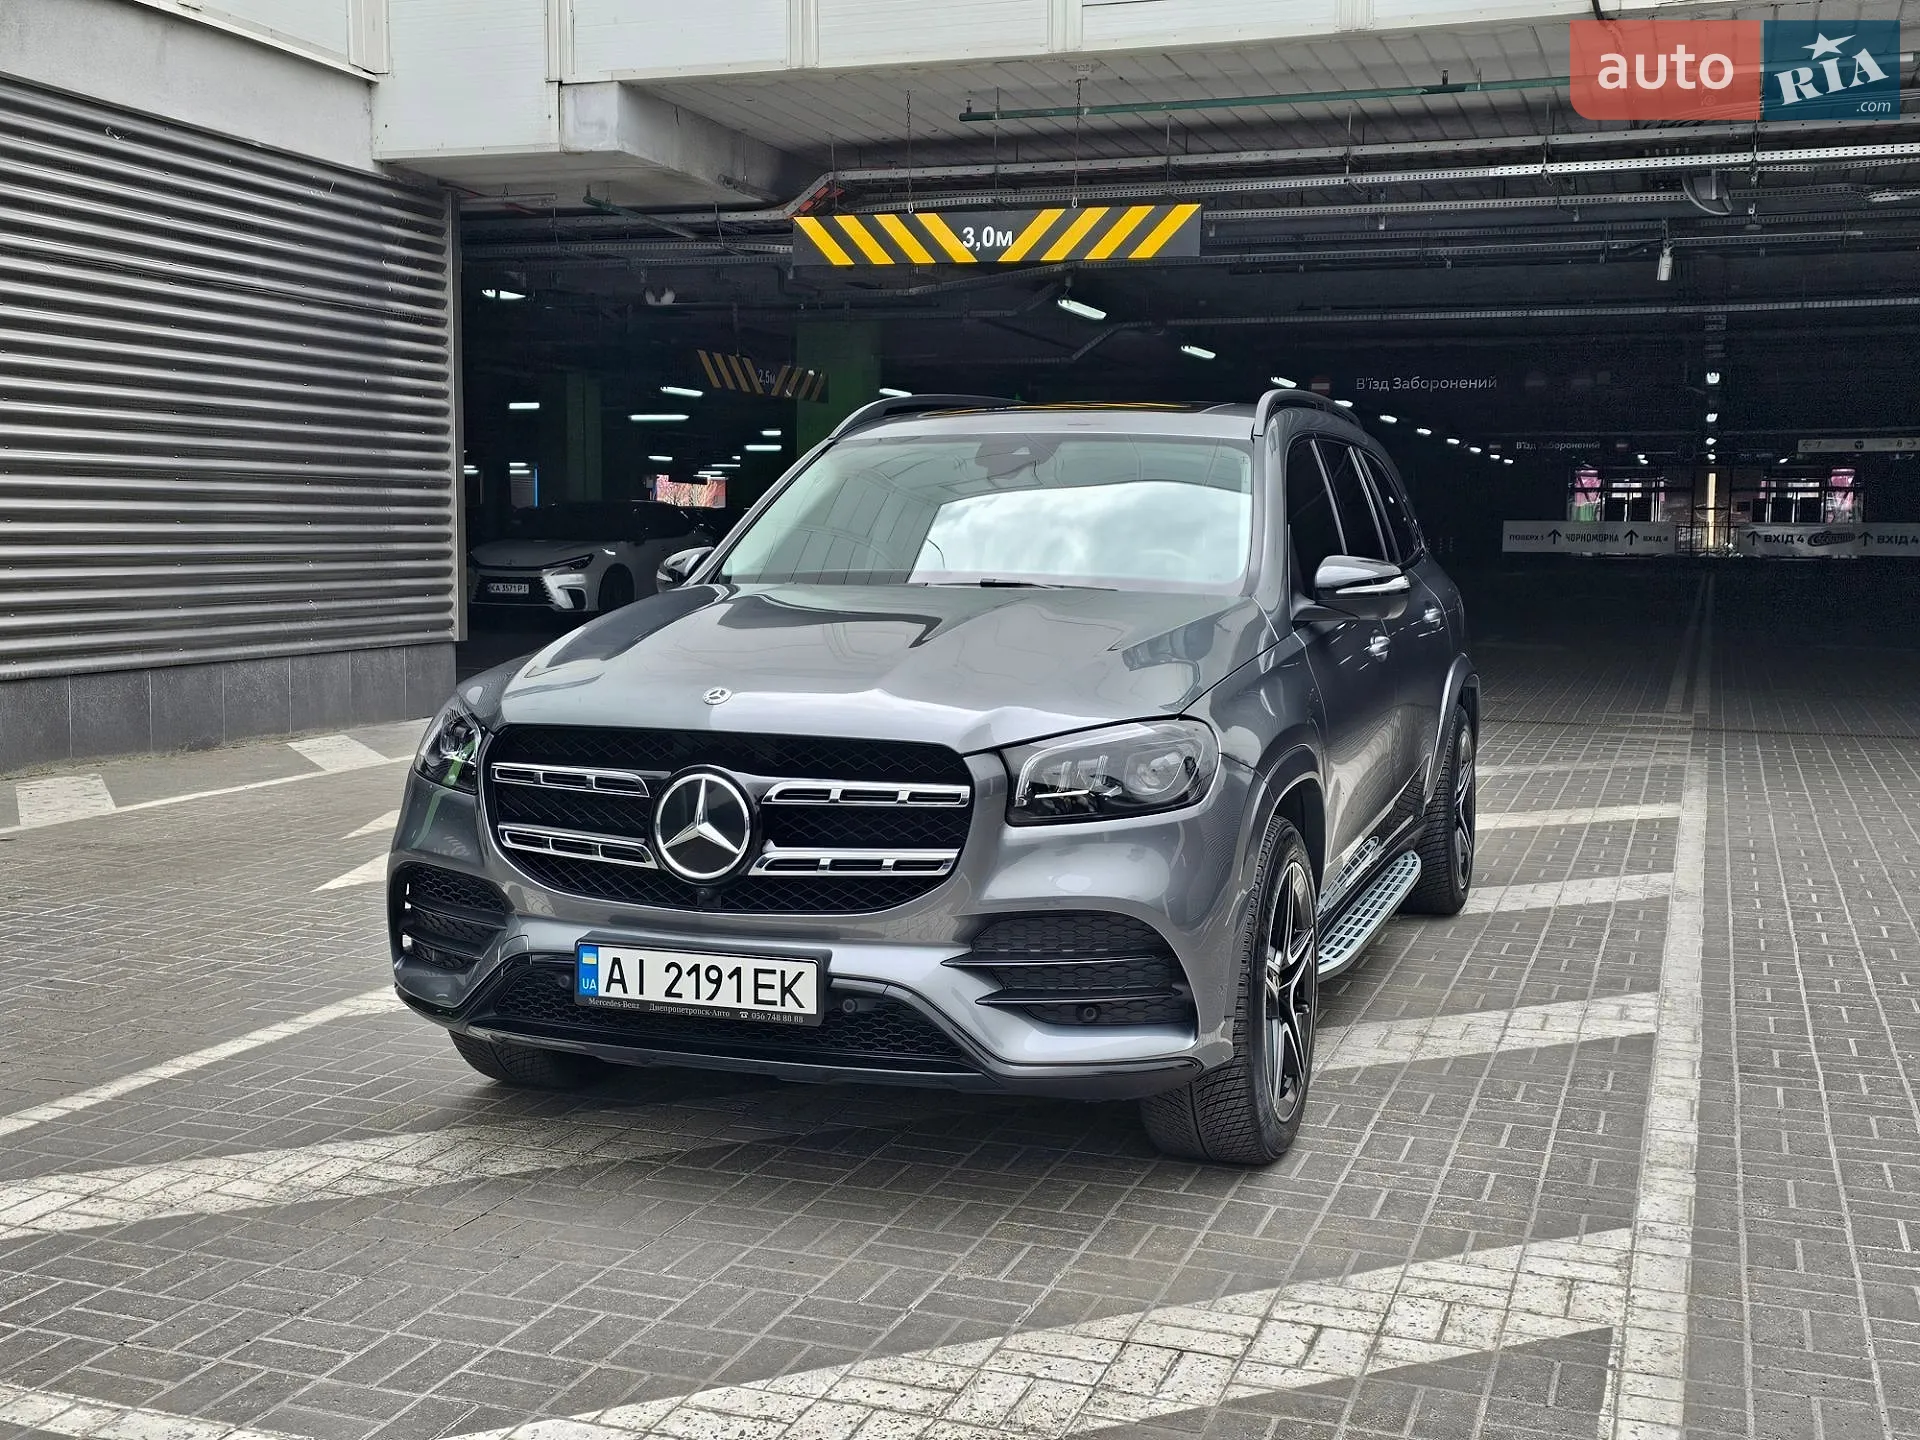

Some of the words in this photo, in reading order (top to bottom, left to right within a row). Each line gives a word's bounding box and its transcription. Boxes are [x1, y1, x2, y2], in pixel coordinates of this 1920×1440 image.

[1392, 376, 1497, 392] Заборонений
[1764, 534, 1795, 545] ВХІД
[1797, 534, 1804, 543] 4
[1877, 534, 1908, 545] ВХІД
[1910, 535, 1919, 544] 4
[606, 957, 644, 996] AI
[582, 978, 597, 991] UA
